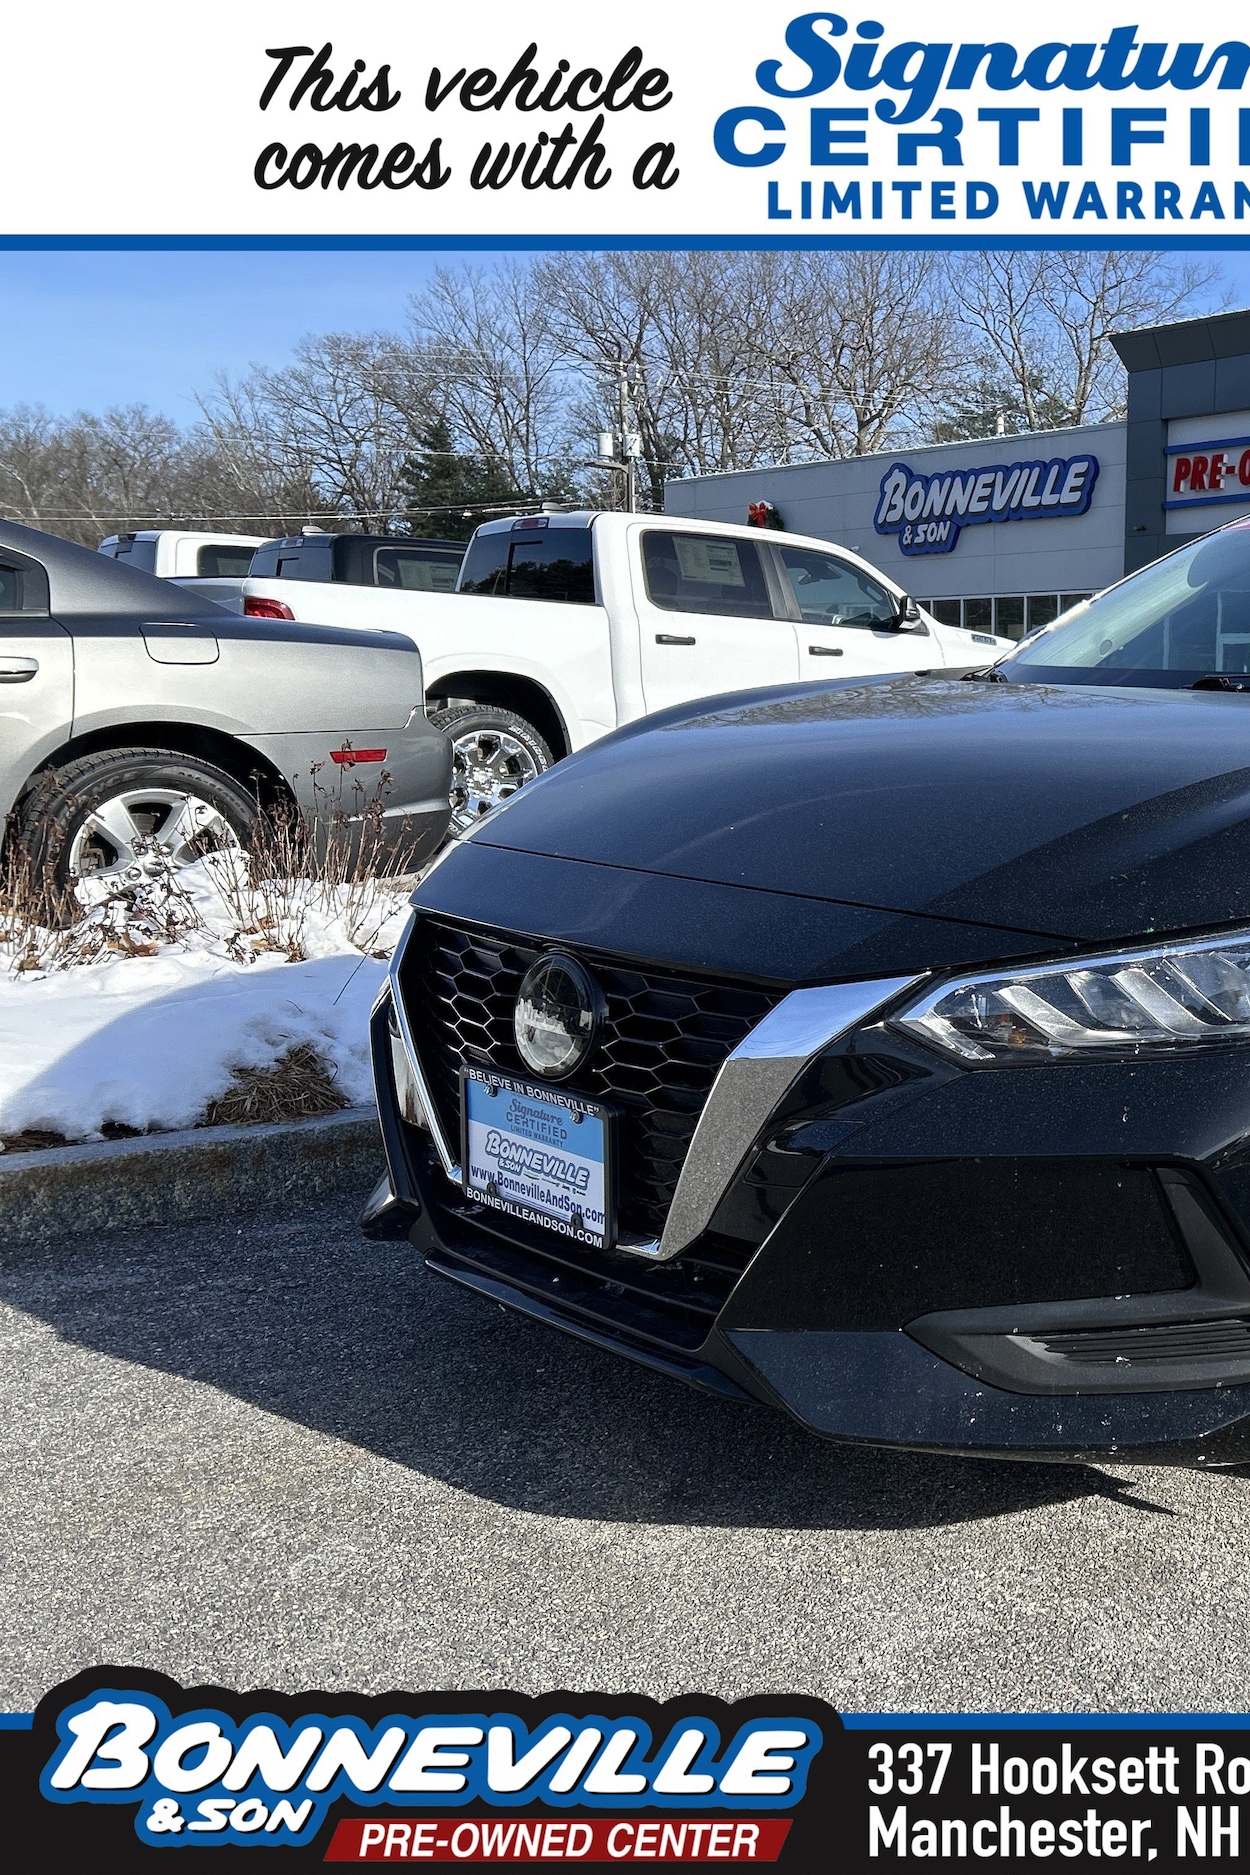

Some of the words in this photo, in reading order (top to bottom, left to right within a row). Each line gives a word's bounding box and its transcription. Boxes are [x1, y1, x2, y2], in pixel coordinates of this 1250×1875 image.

[878, 461, 1089, 524] BONNEVILLE
[513, 1082, 525, 1095] IN
[506, 1111, 568, 1140] CERTIFIED
[509, 1098, 564, 1127] Signature
[510, 1124, 533, 1138] LIMITED
[533, 1132, 564, 1148] WARRANTY
[486, 1132, 589, 1188] BONNEVILLE
[466, 1187, 603, 1249] BONNEVILLEANDSON.COM
